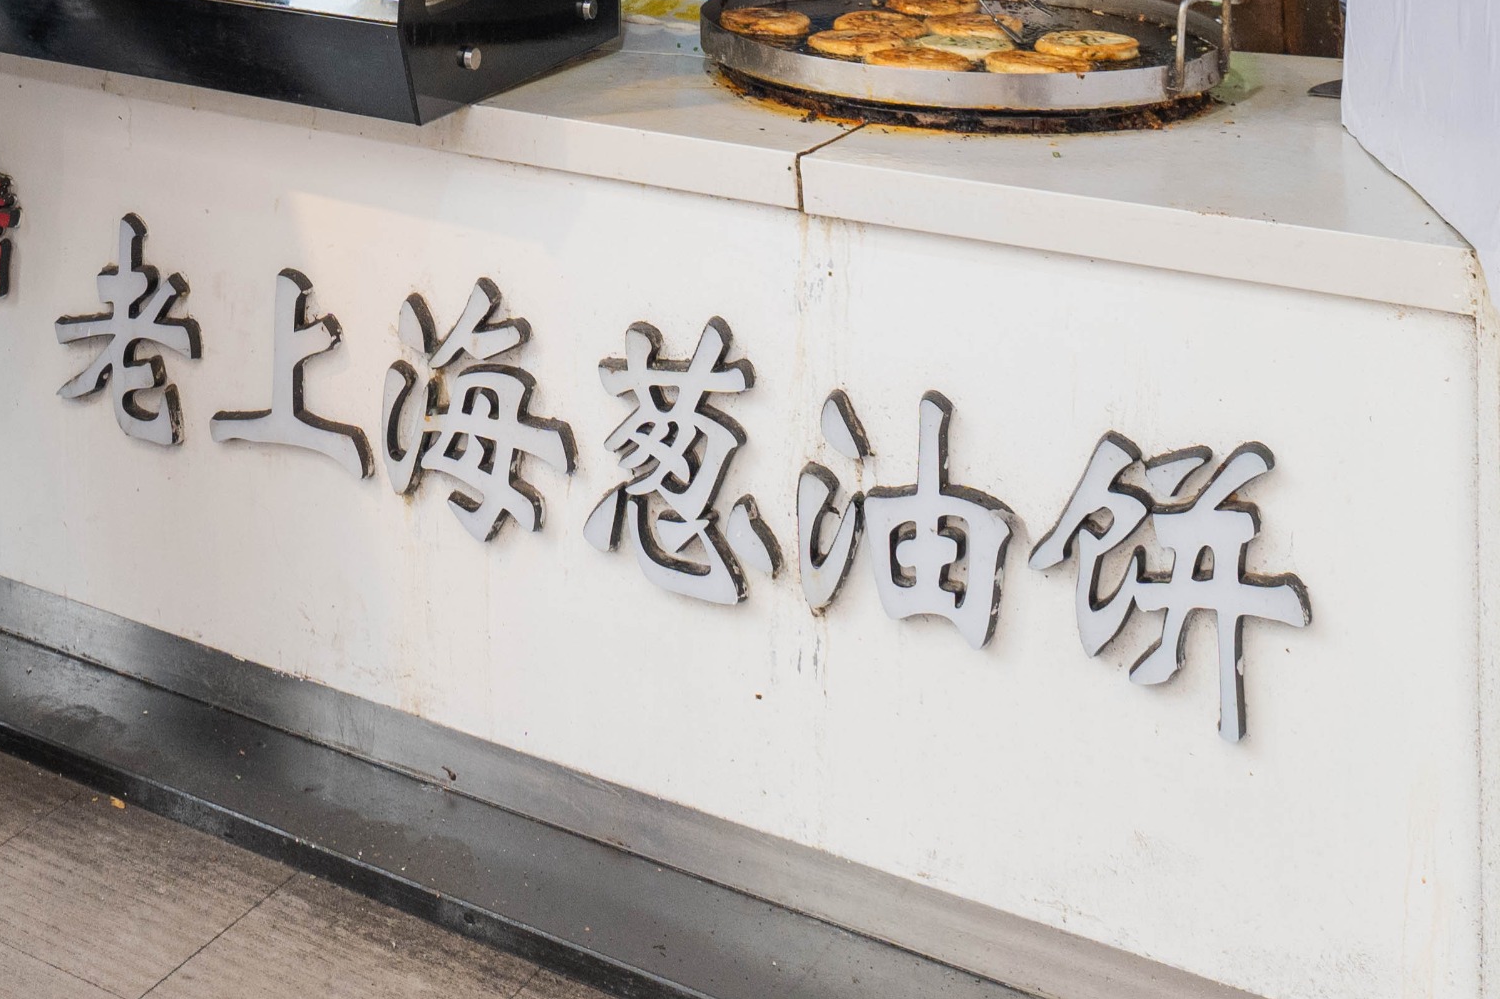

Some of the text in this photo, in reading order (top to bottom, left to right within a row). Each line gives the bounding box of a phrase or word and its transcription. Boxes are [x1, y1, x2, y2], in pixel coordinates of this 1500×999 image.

[55, 211, 1313, 745] 老上海葱油饼
